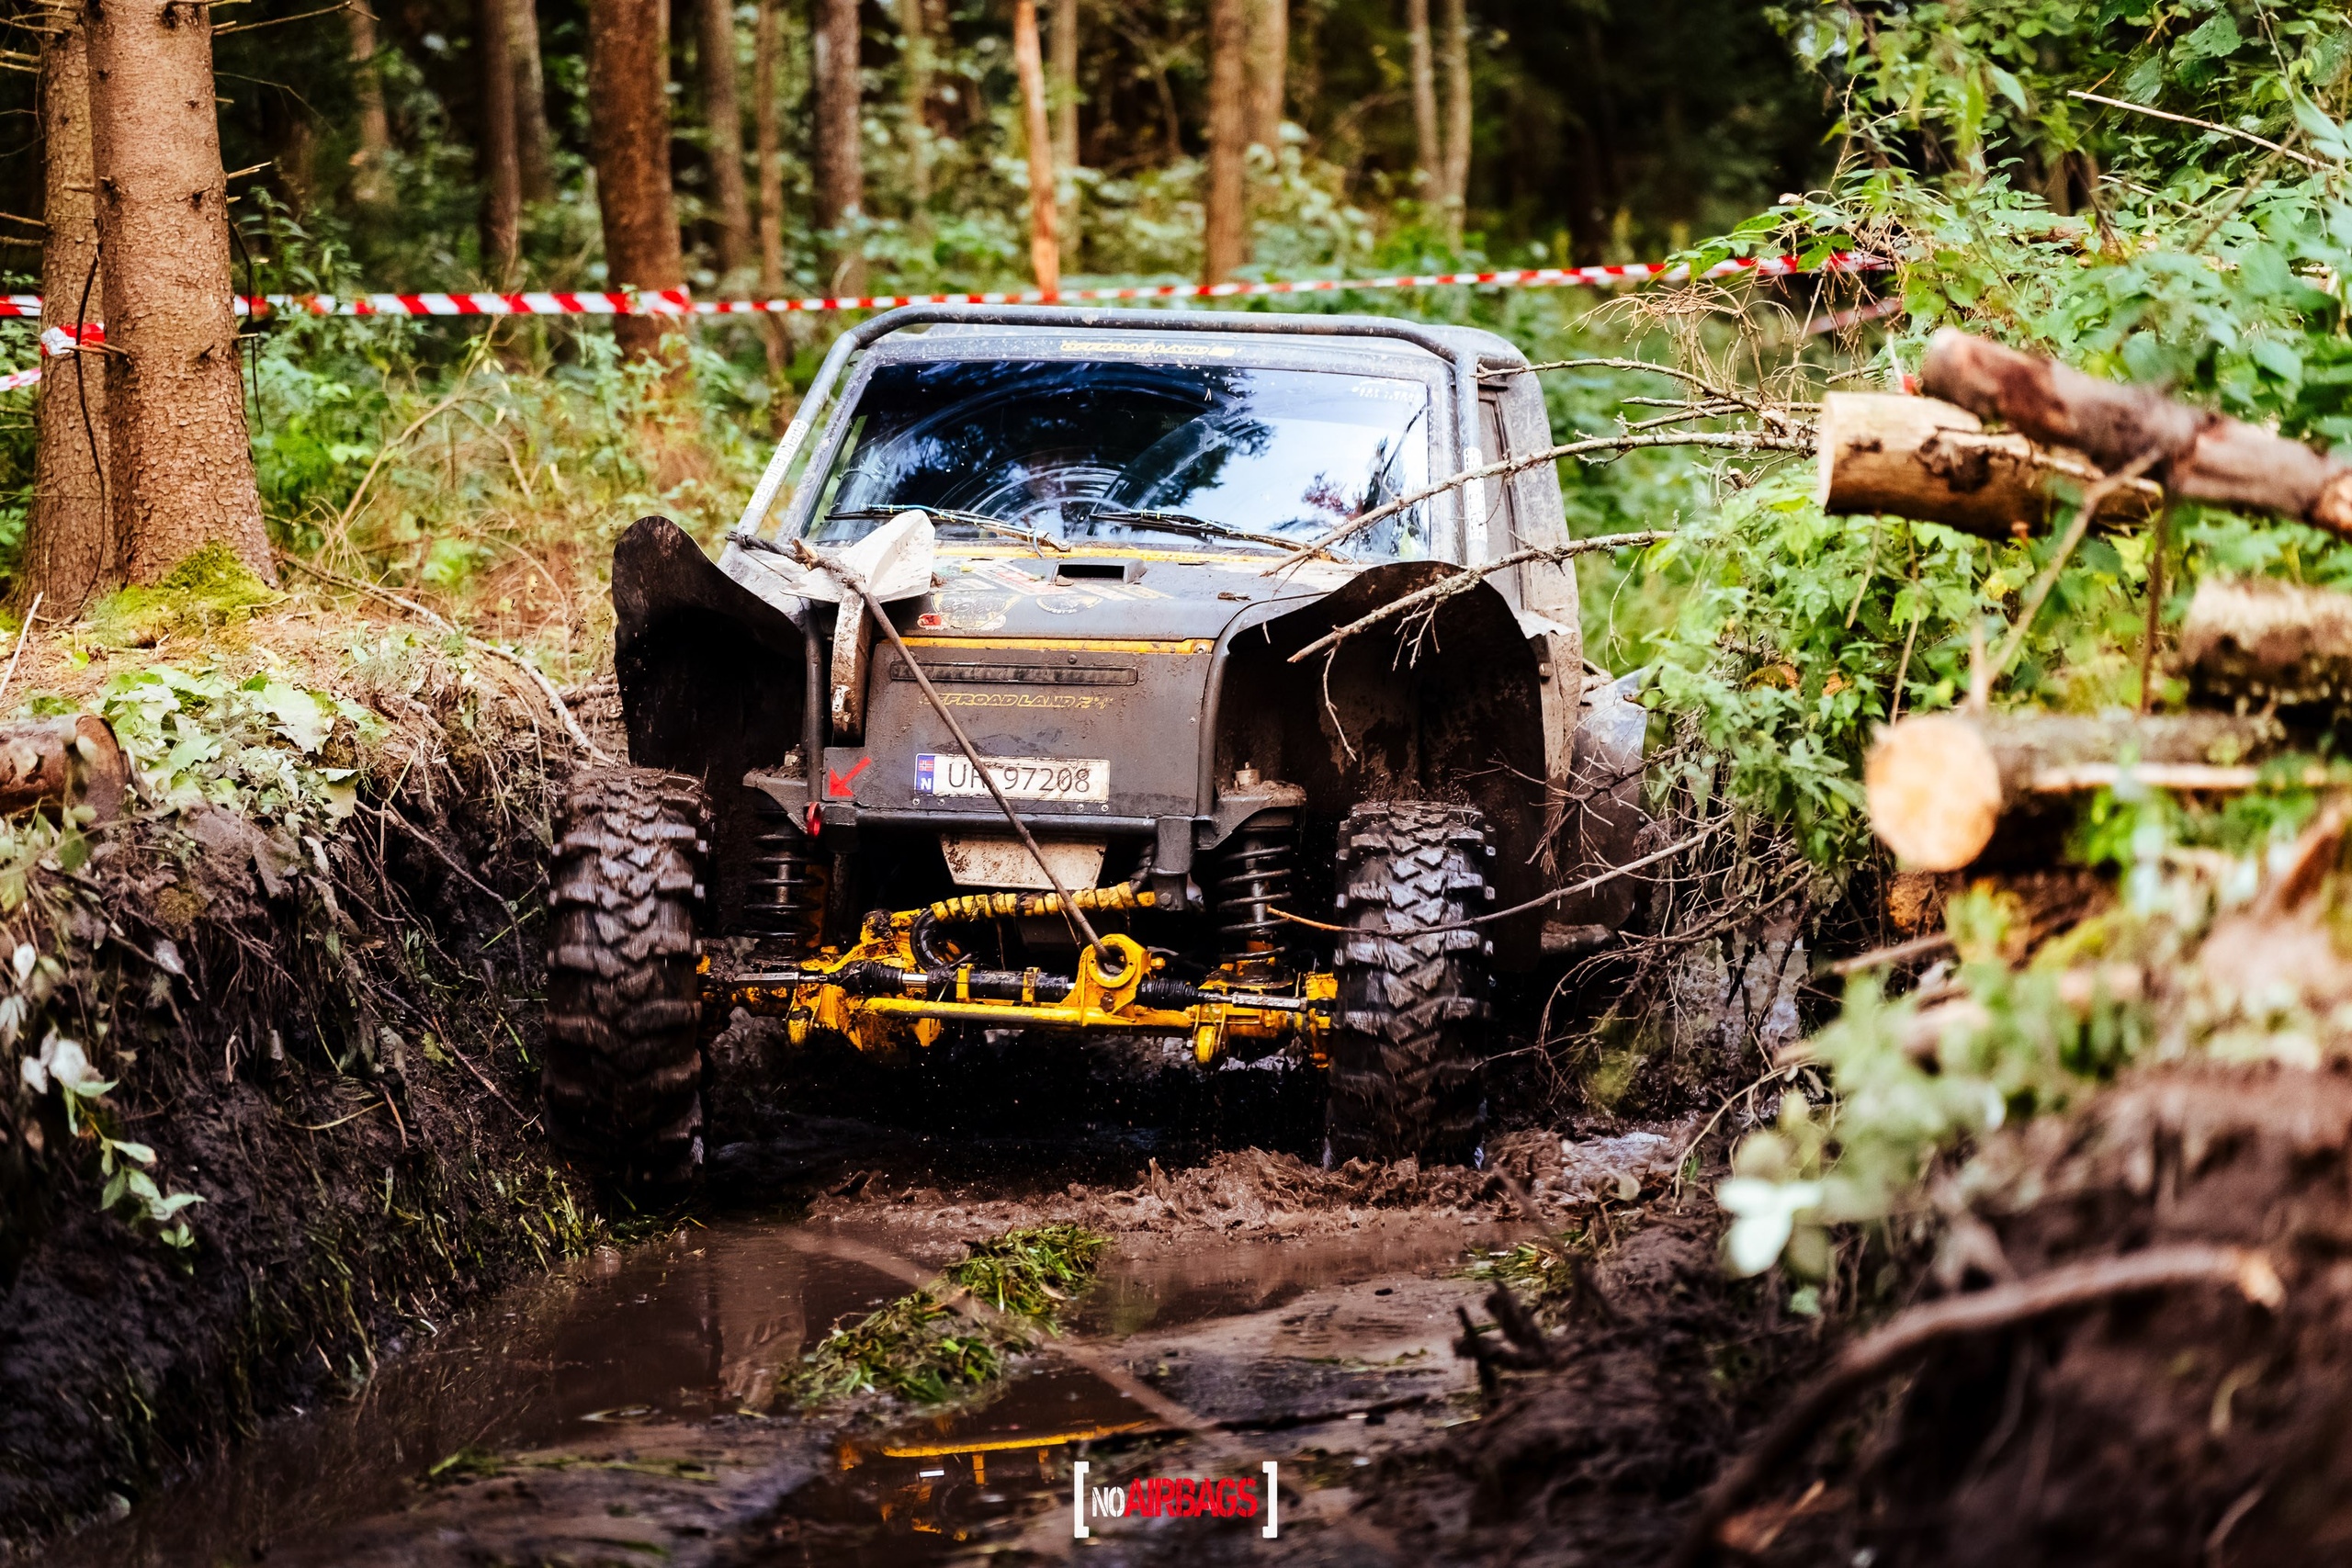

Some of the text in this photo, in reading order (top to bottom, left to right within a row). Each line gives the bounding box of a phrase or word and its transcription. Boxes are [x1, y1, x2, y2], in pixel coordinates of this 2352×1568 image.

[1017, 694, 1077, 708] LAND
[921, 777, 933, 790] N
[1003, 767, 1091, 792] 97208
